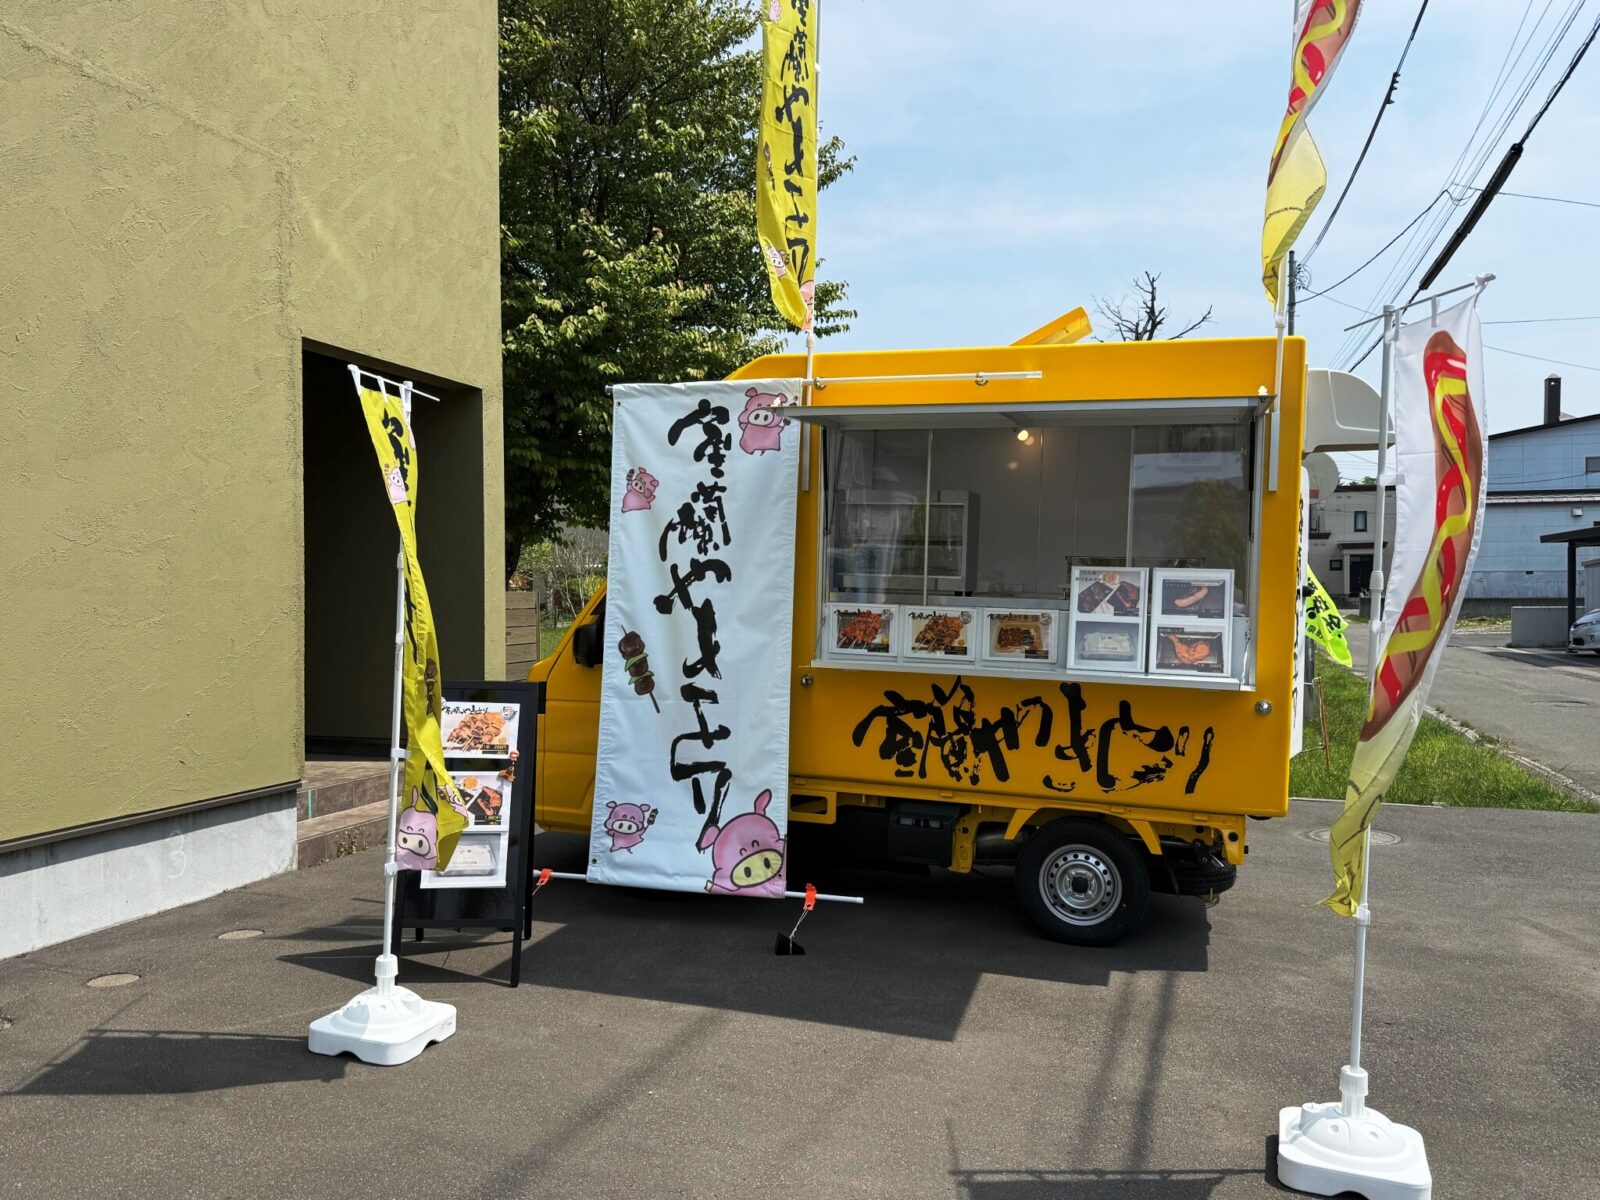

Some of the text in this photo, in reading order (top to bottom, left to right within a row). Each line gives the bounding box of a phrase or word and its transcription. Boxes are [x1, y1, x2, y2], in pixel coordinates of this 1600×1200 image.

[653, 399, 732, 853] 室蘭やきとり
[852, 675, 1213, 795] 室蘭やきとり
